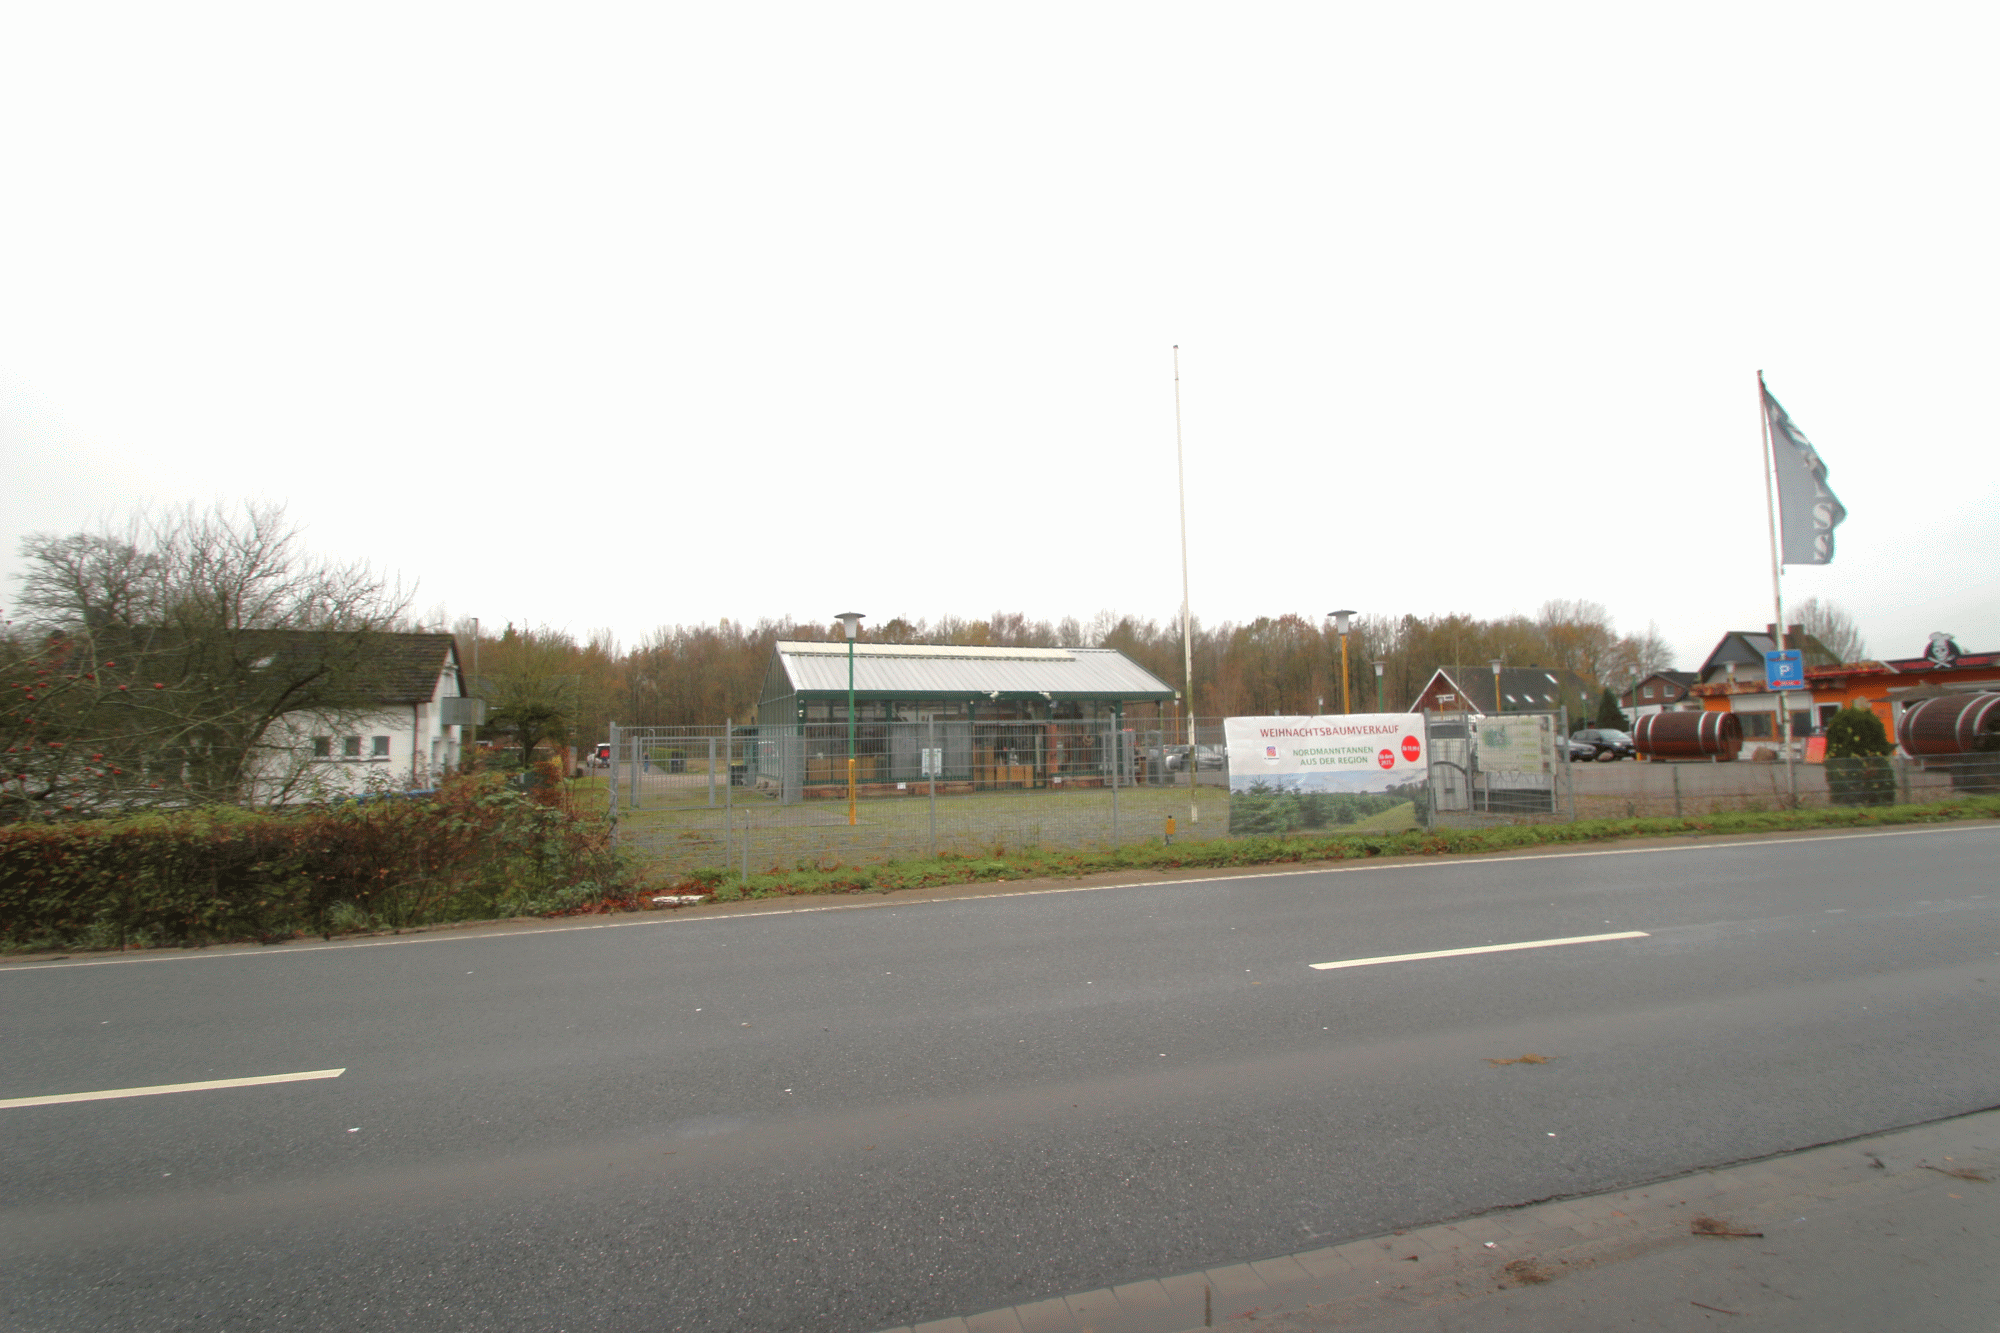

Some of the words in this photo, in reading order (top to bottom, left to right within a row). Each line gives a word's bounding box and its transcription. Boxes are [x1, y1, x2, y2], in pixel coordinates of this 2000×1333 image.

[1260, 725, 1399, 737] WEIHNACHTSBAUMVERKAUF
[1293, 746, 1374, 756] NORDMANNTANNEN
[1300, 758, 1317, 766] AUS
[1320, 757, 1336, 765] DER
[1338, 756, 1368, 764] REGION
